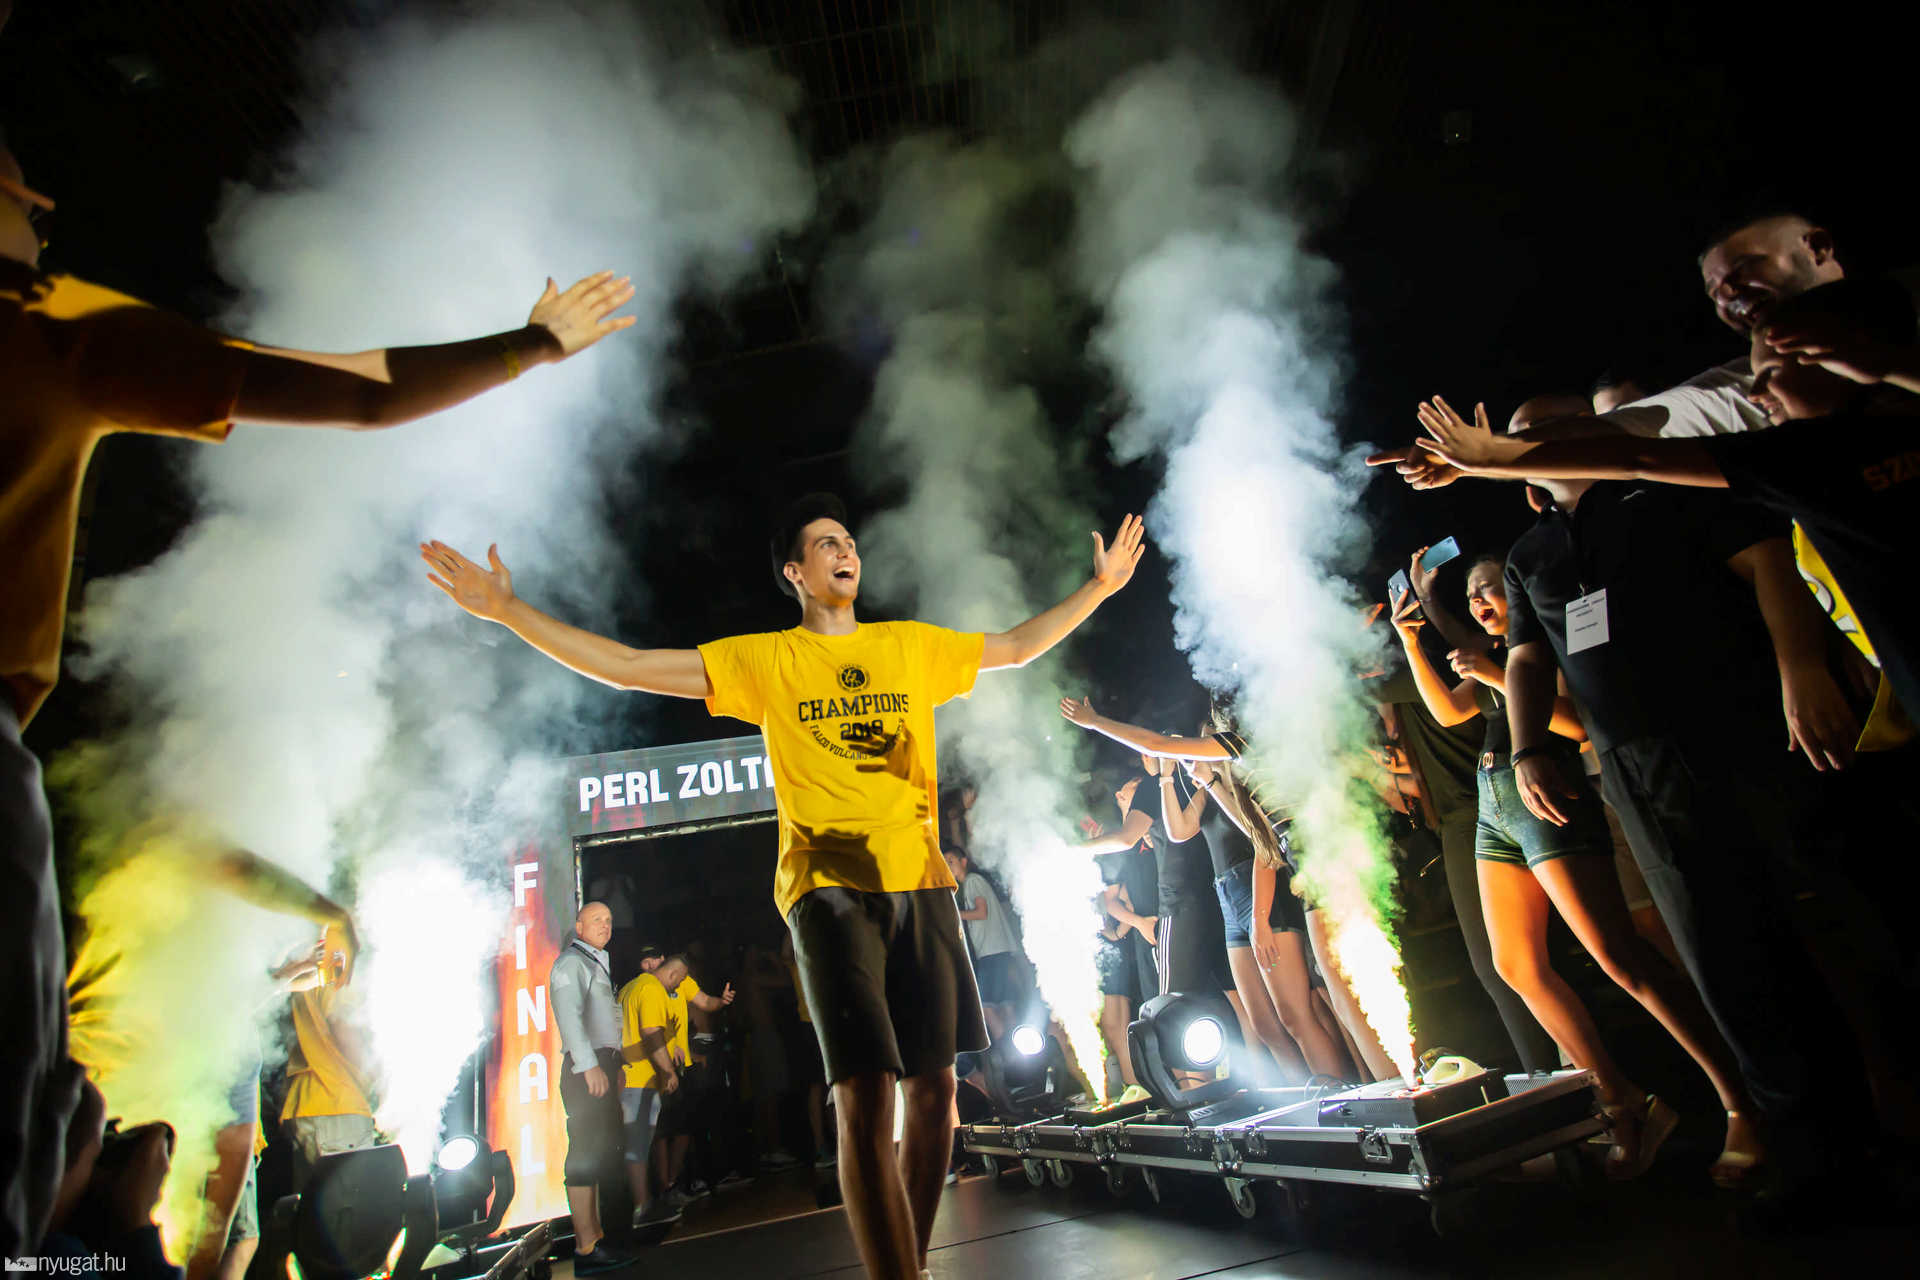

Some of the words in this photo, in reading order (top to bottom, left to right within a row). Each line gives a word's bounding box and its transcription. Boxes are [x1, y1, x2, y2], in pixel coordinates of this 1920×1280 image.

[798, 693, 909, 722] CHAMPIONS
[809, 724, 830, 749] FALCO
[840, 719, 883, 740] 2019
[579, 768, 670, 812] PERL
[513, 861, 549, 1177] FINAL
